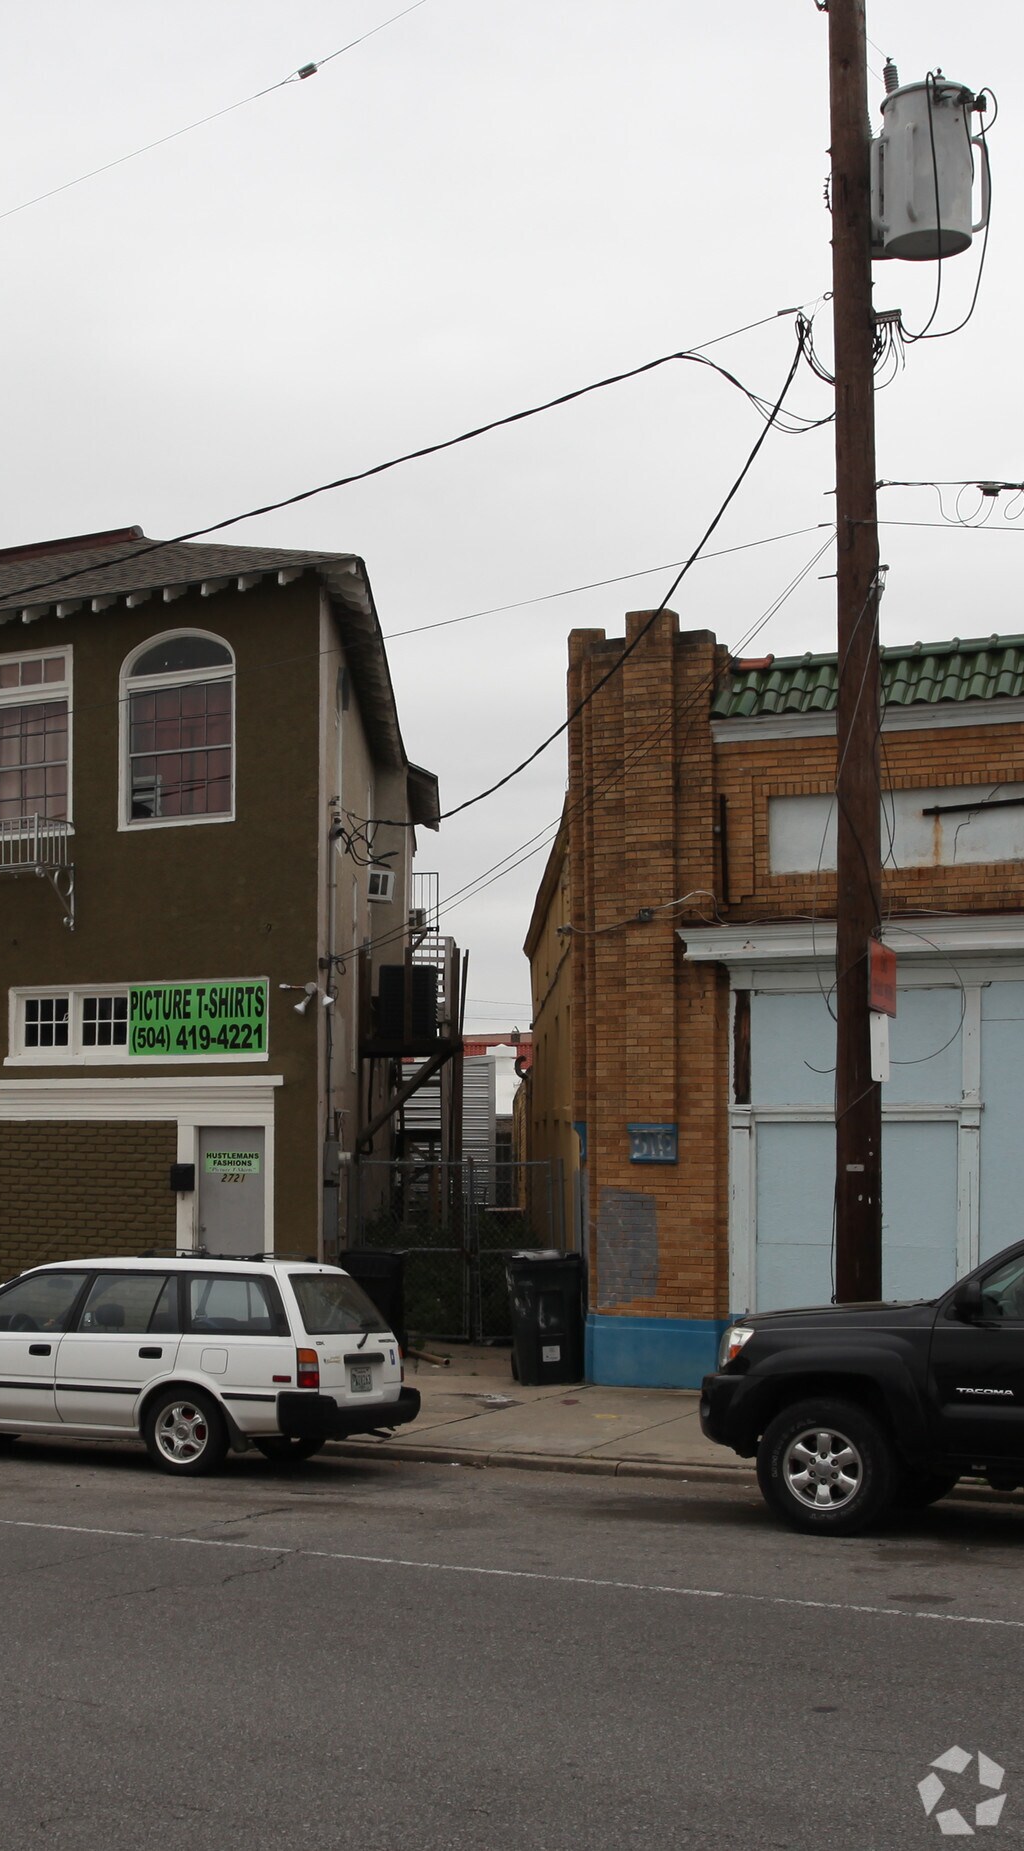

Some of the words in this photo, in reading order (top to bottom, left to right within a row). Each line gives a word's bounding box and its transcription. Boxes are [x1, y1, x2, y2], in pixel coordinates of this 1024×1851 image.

[130, 988, 192, 1021] PICTURE
[196, 986, 264, 1019] T-SHIRTS
[132, 1024, 171, 1052] (504)
[176, 1023, 263, 1050] 419-4221
[221, 1174, 245, 1182] 2721
[956, 1388, 1014, 1396] TACOMA
